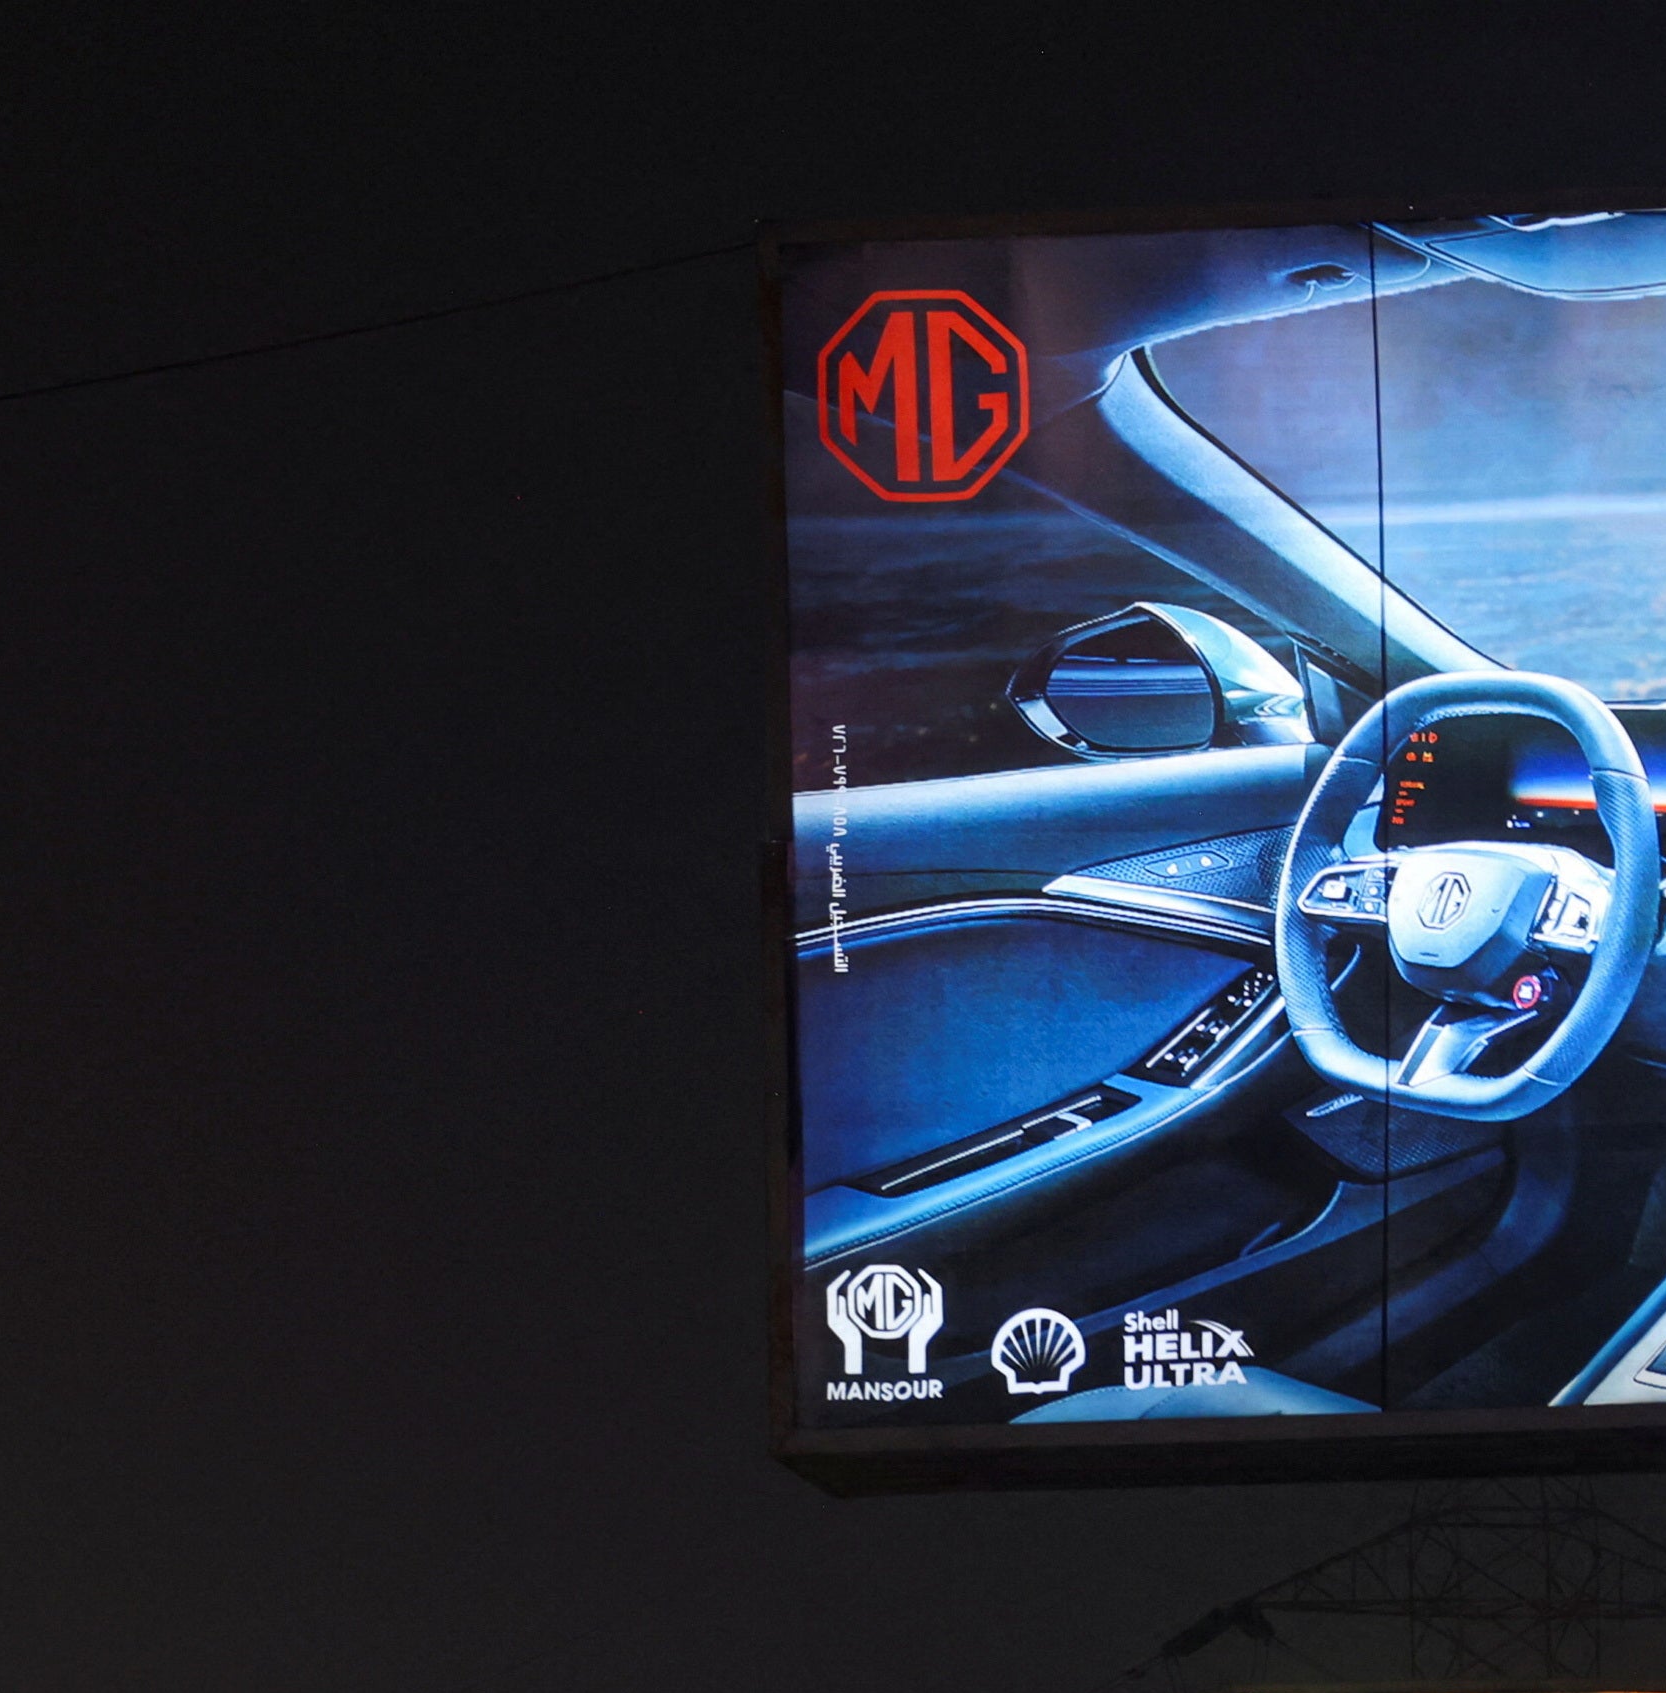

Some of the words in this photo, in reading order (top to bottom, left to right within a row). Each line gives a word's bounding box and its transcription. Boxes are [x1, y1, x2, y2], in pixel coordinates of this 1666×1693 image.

[836, 309, 1009, 484] MG
[856, 1273, 914, 1332] MG
[1124, 1308, 1179, 1332] Shell
[1123, 1321, 1253, 1362] HELIX
[826, 1379, 944, 1402] MANSOUR
[1124, 1361, 1248, 1390] ULTRA
